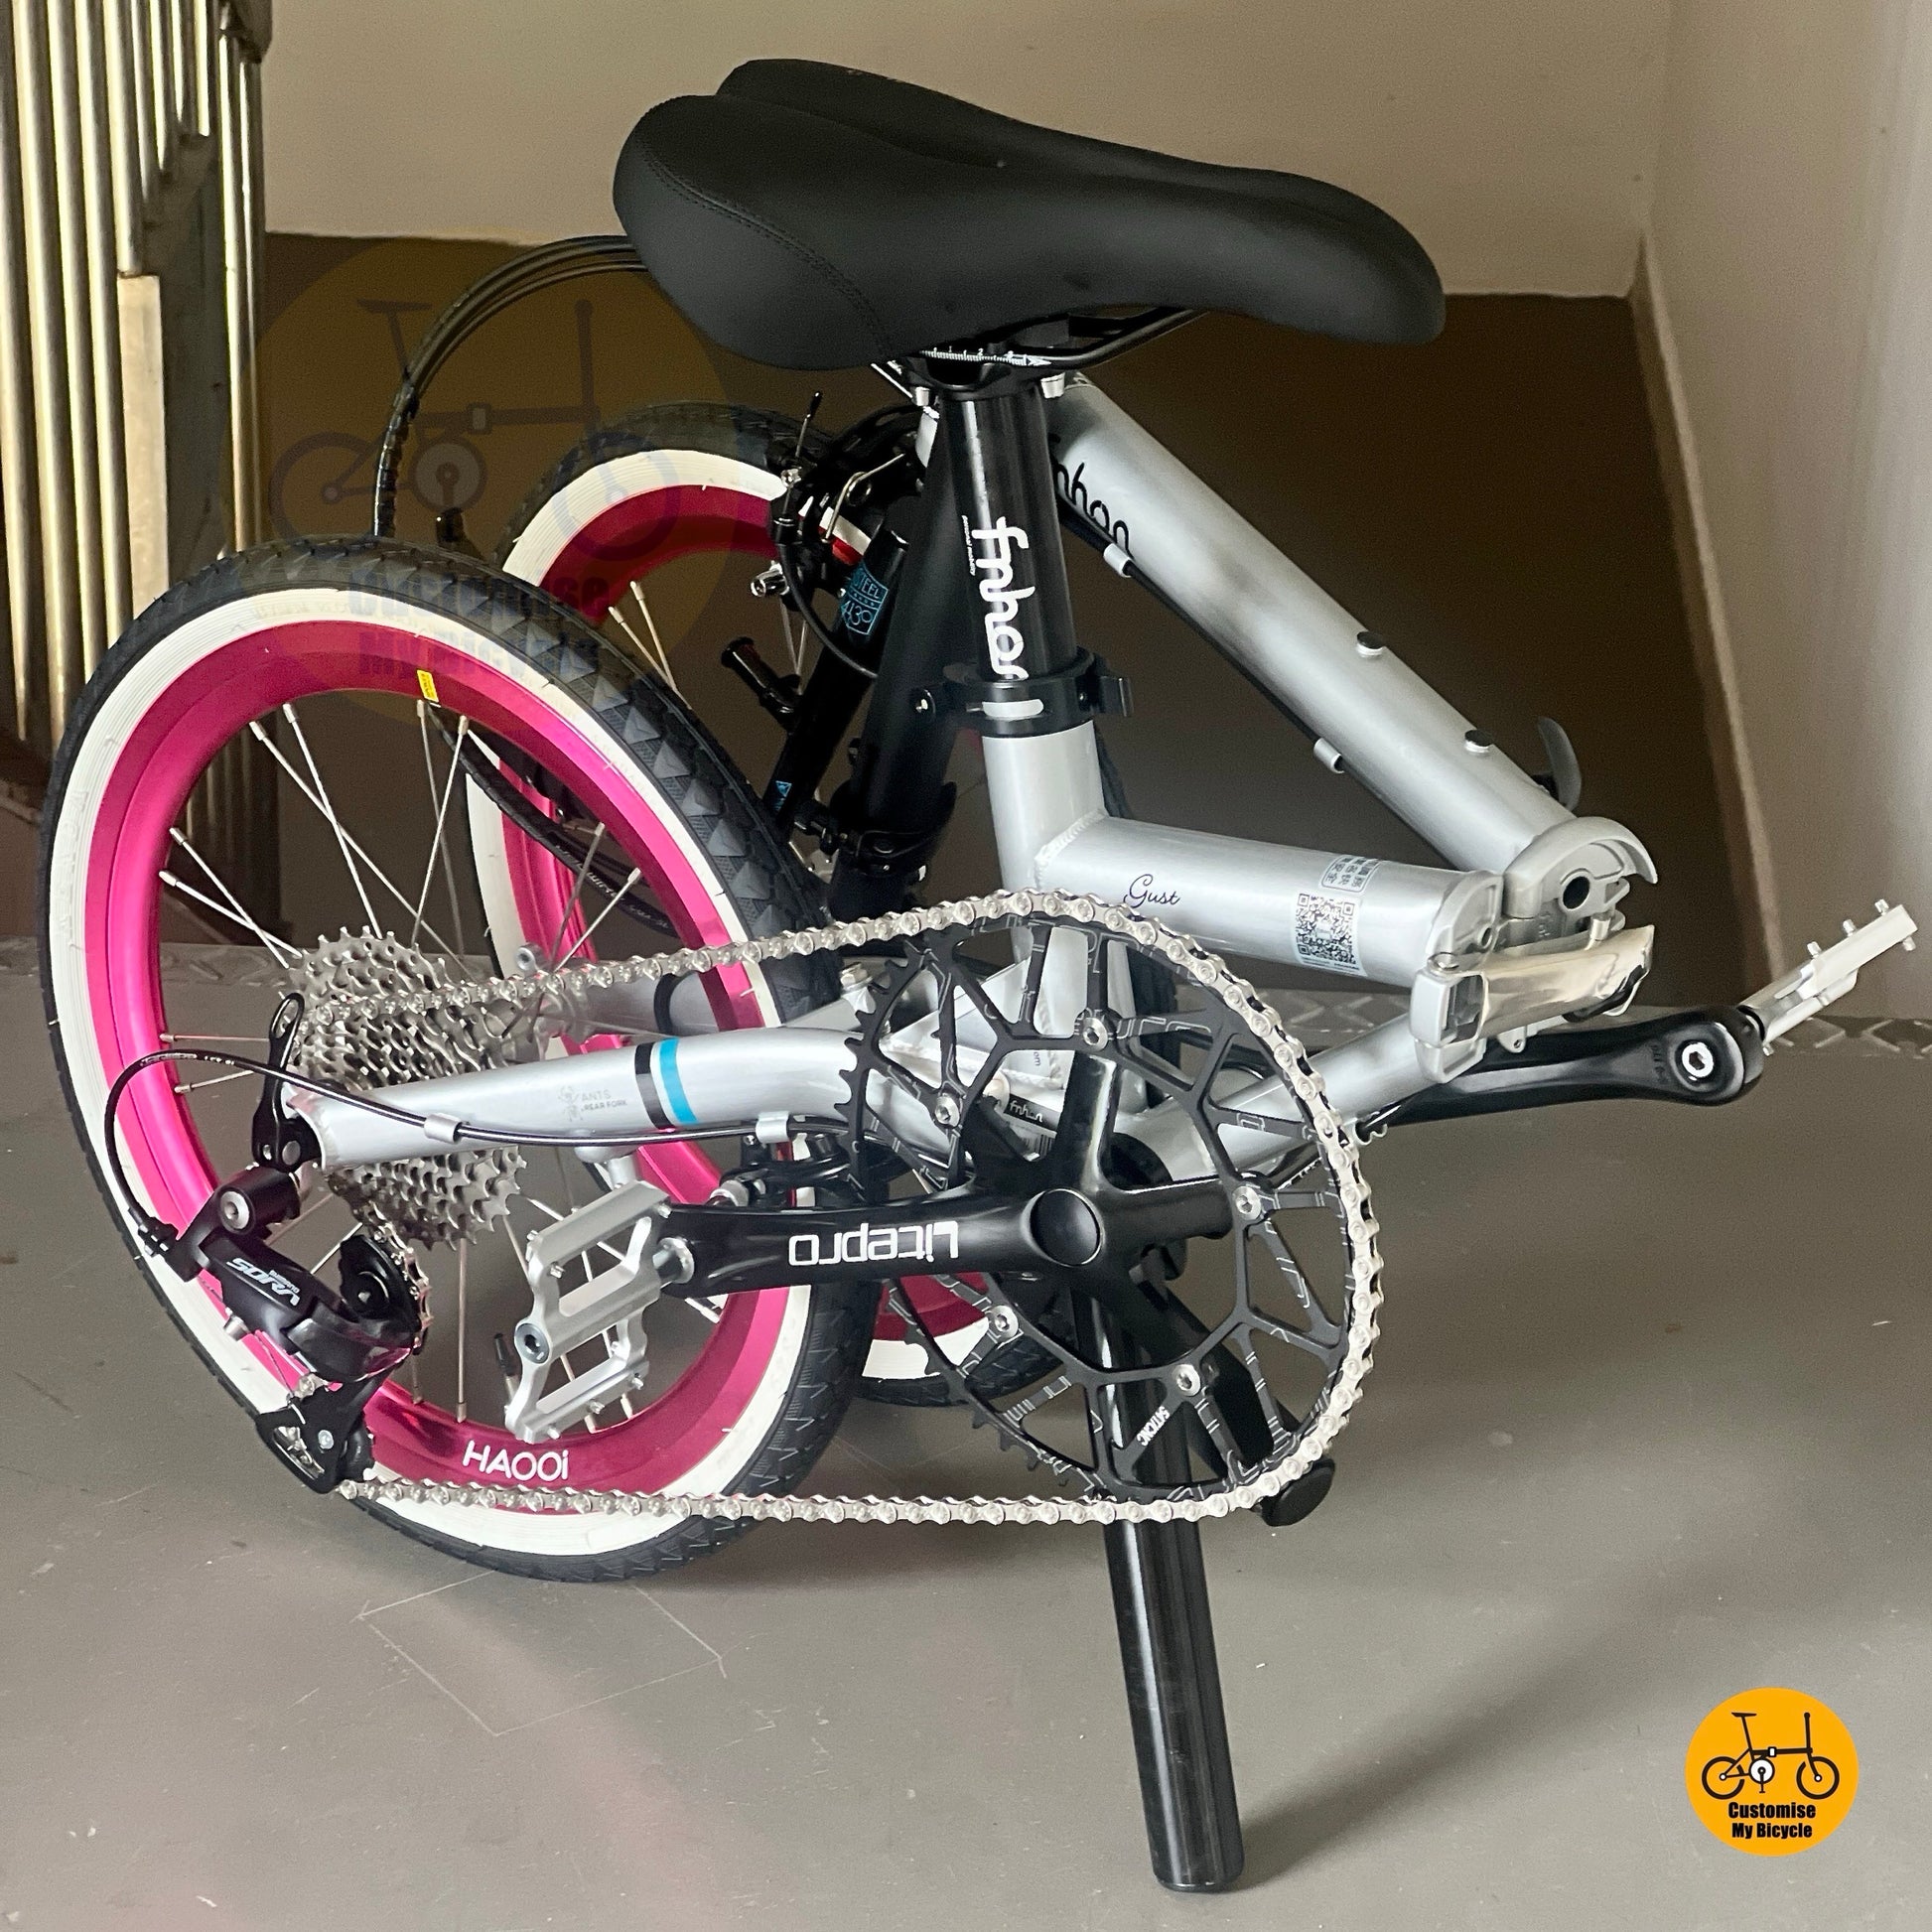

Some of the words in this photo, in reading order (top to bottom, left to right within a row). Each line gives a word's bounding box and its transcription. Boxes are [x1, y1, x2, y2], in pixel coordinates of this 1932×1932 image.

[1048, 433, 1136, 562] nhon
[1123, 873, 1180, 908] Gust
[788, 1220, 959, 1266] Litepro
[226, 1257, 301, 1307] SORA
